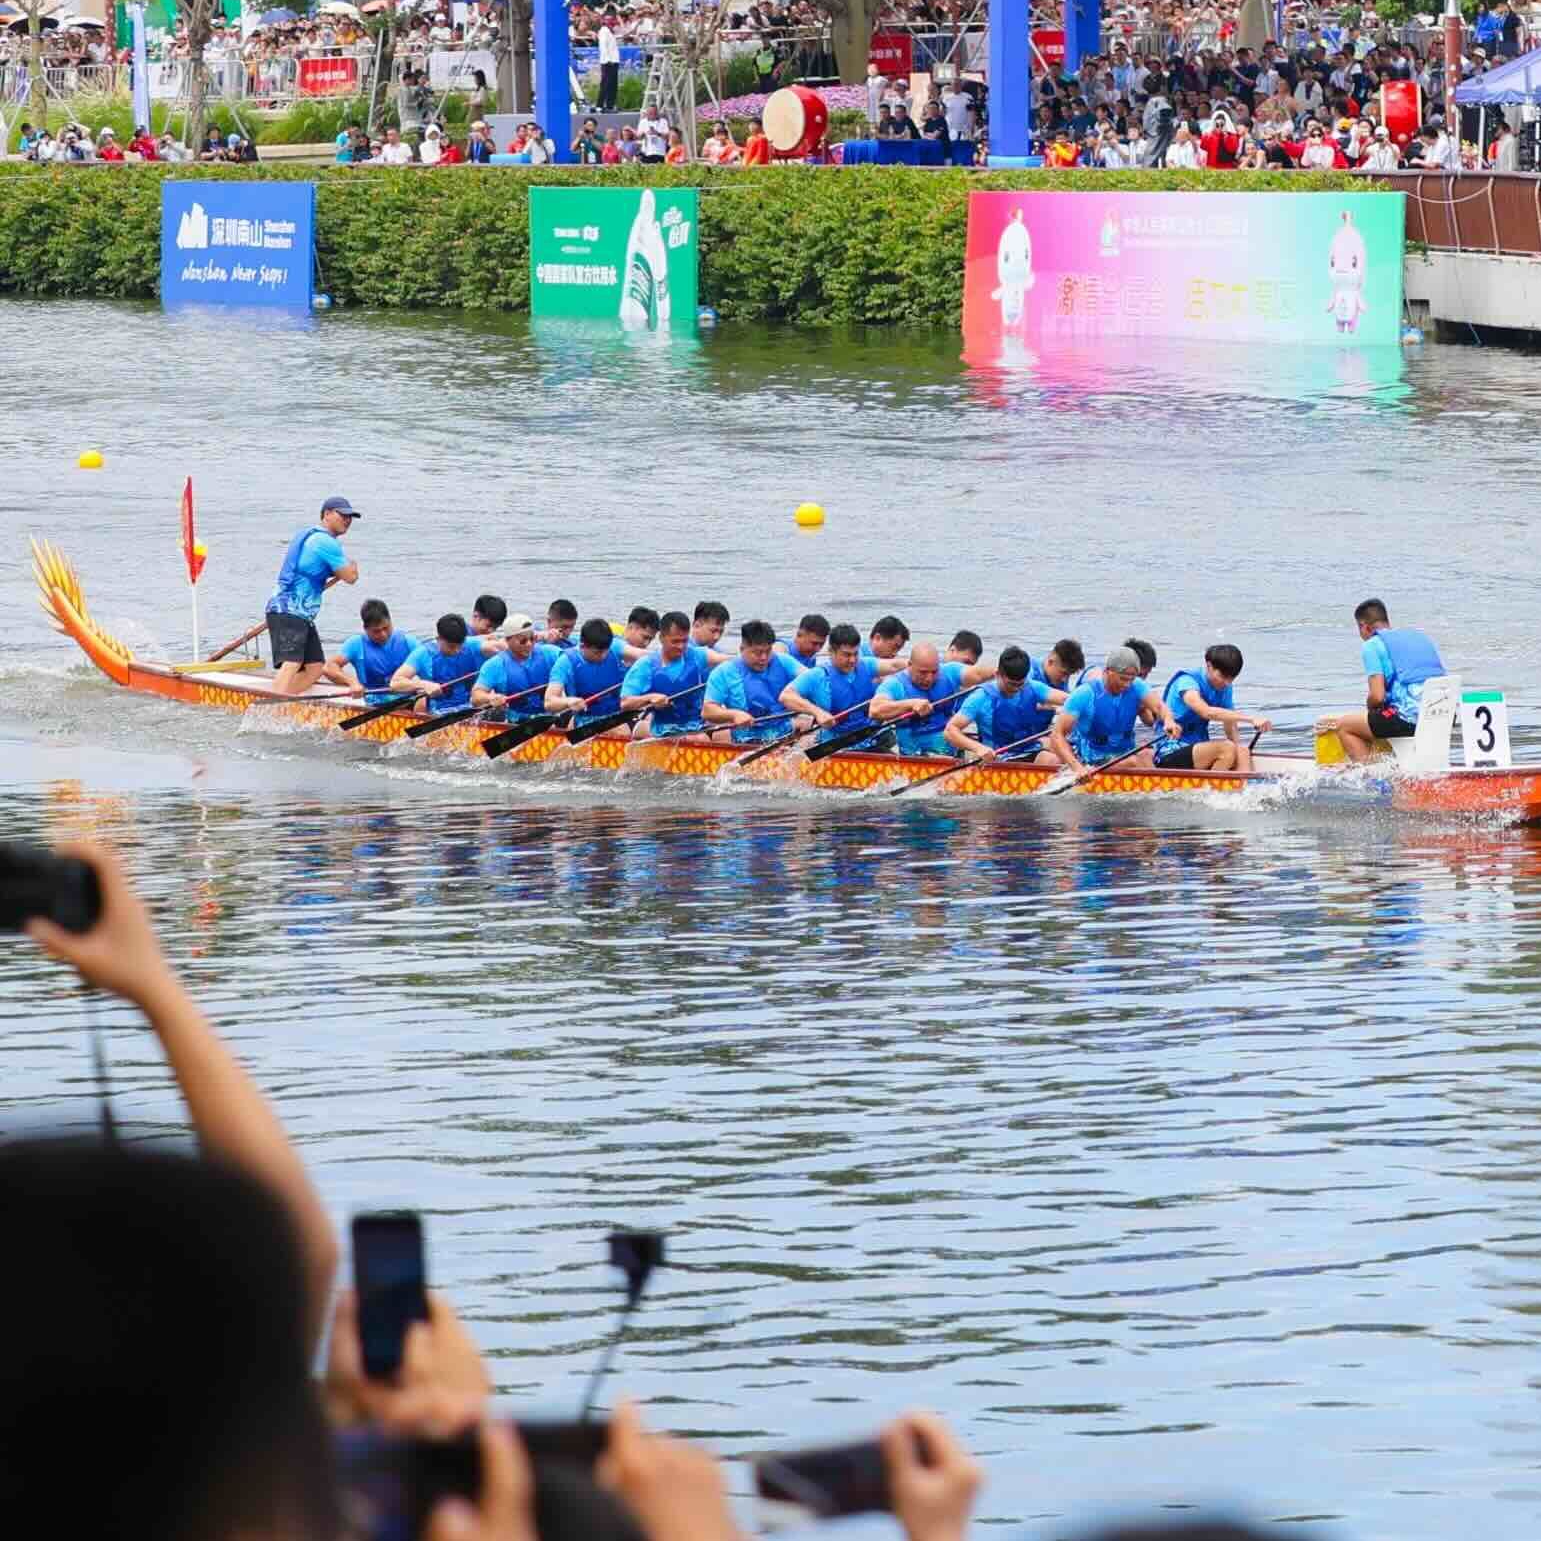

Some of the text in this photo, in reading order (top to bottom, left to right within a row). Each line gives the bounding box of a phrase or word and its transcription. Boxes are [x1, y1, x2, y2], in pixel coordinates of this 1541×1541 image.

[210, 217, 263, 247] 深圳南山
[1474, 705, 1496, 753] 3
